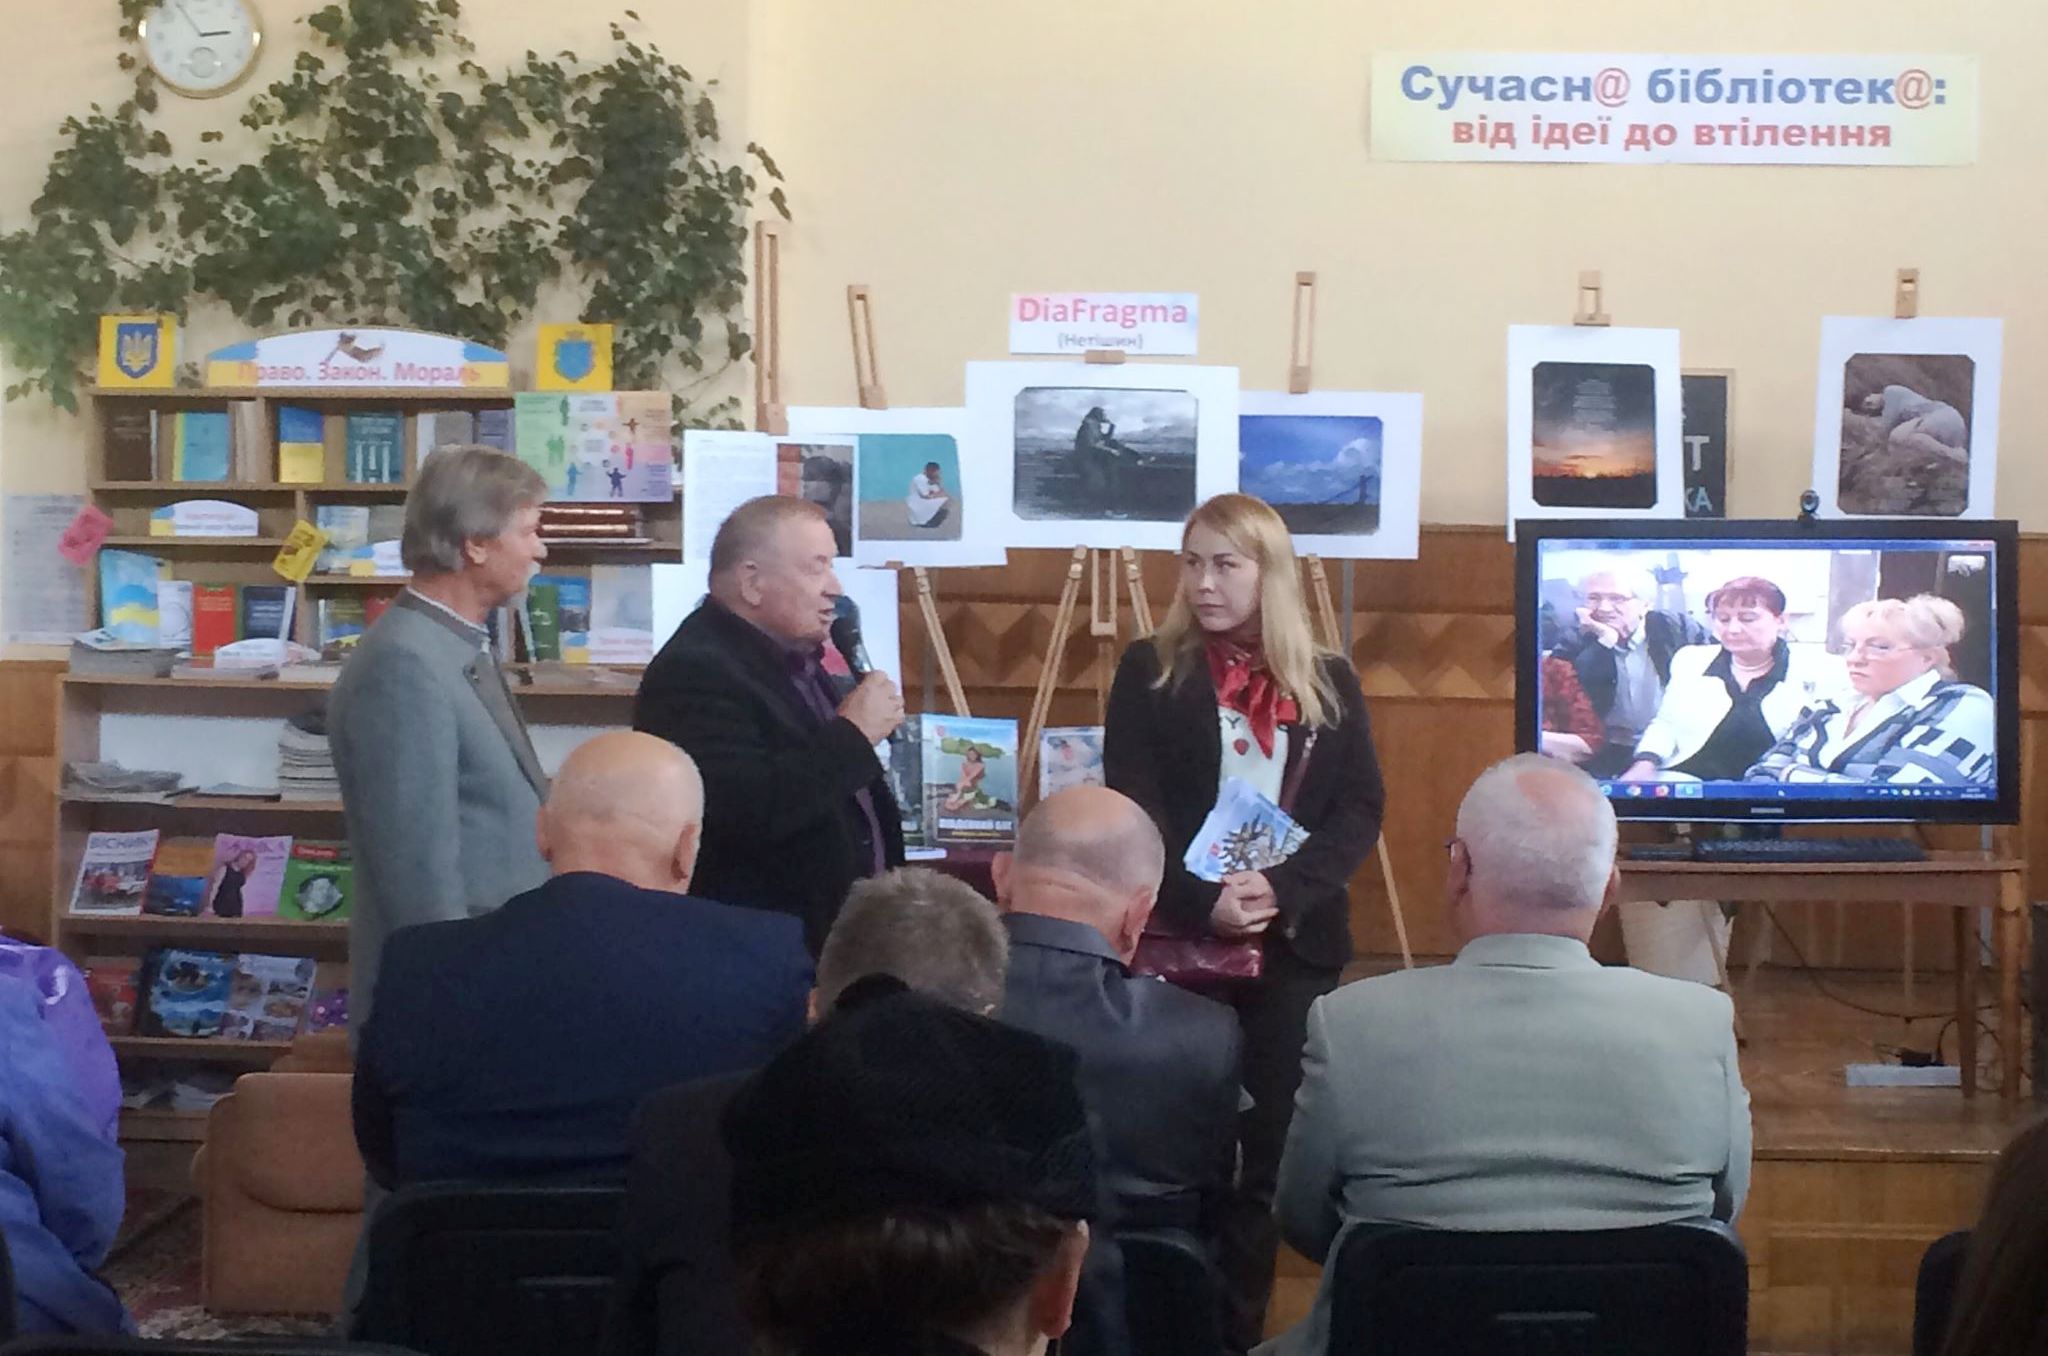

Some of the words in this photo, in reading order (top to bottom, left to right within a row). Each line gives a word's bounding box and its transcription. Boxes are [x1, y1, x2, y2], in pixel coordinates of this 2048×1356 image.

[1401, 65, 1631, 111] Сучасн@
[1647, 67, 1946, 110] бібліотек@:
[1452, 113, 1517, 150] від
[1531, 113, 1613, 151] ідеї
[1623, 122, 1679, 152] до
[1693, 116, 1892, 148] втілення
[1018, 297, 1189, 329] DiaFragma
[238, 362, 311, 384] Право.
[317, 361, 388, 381] Закон.
[394, 361, 481, 385] Мораль
